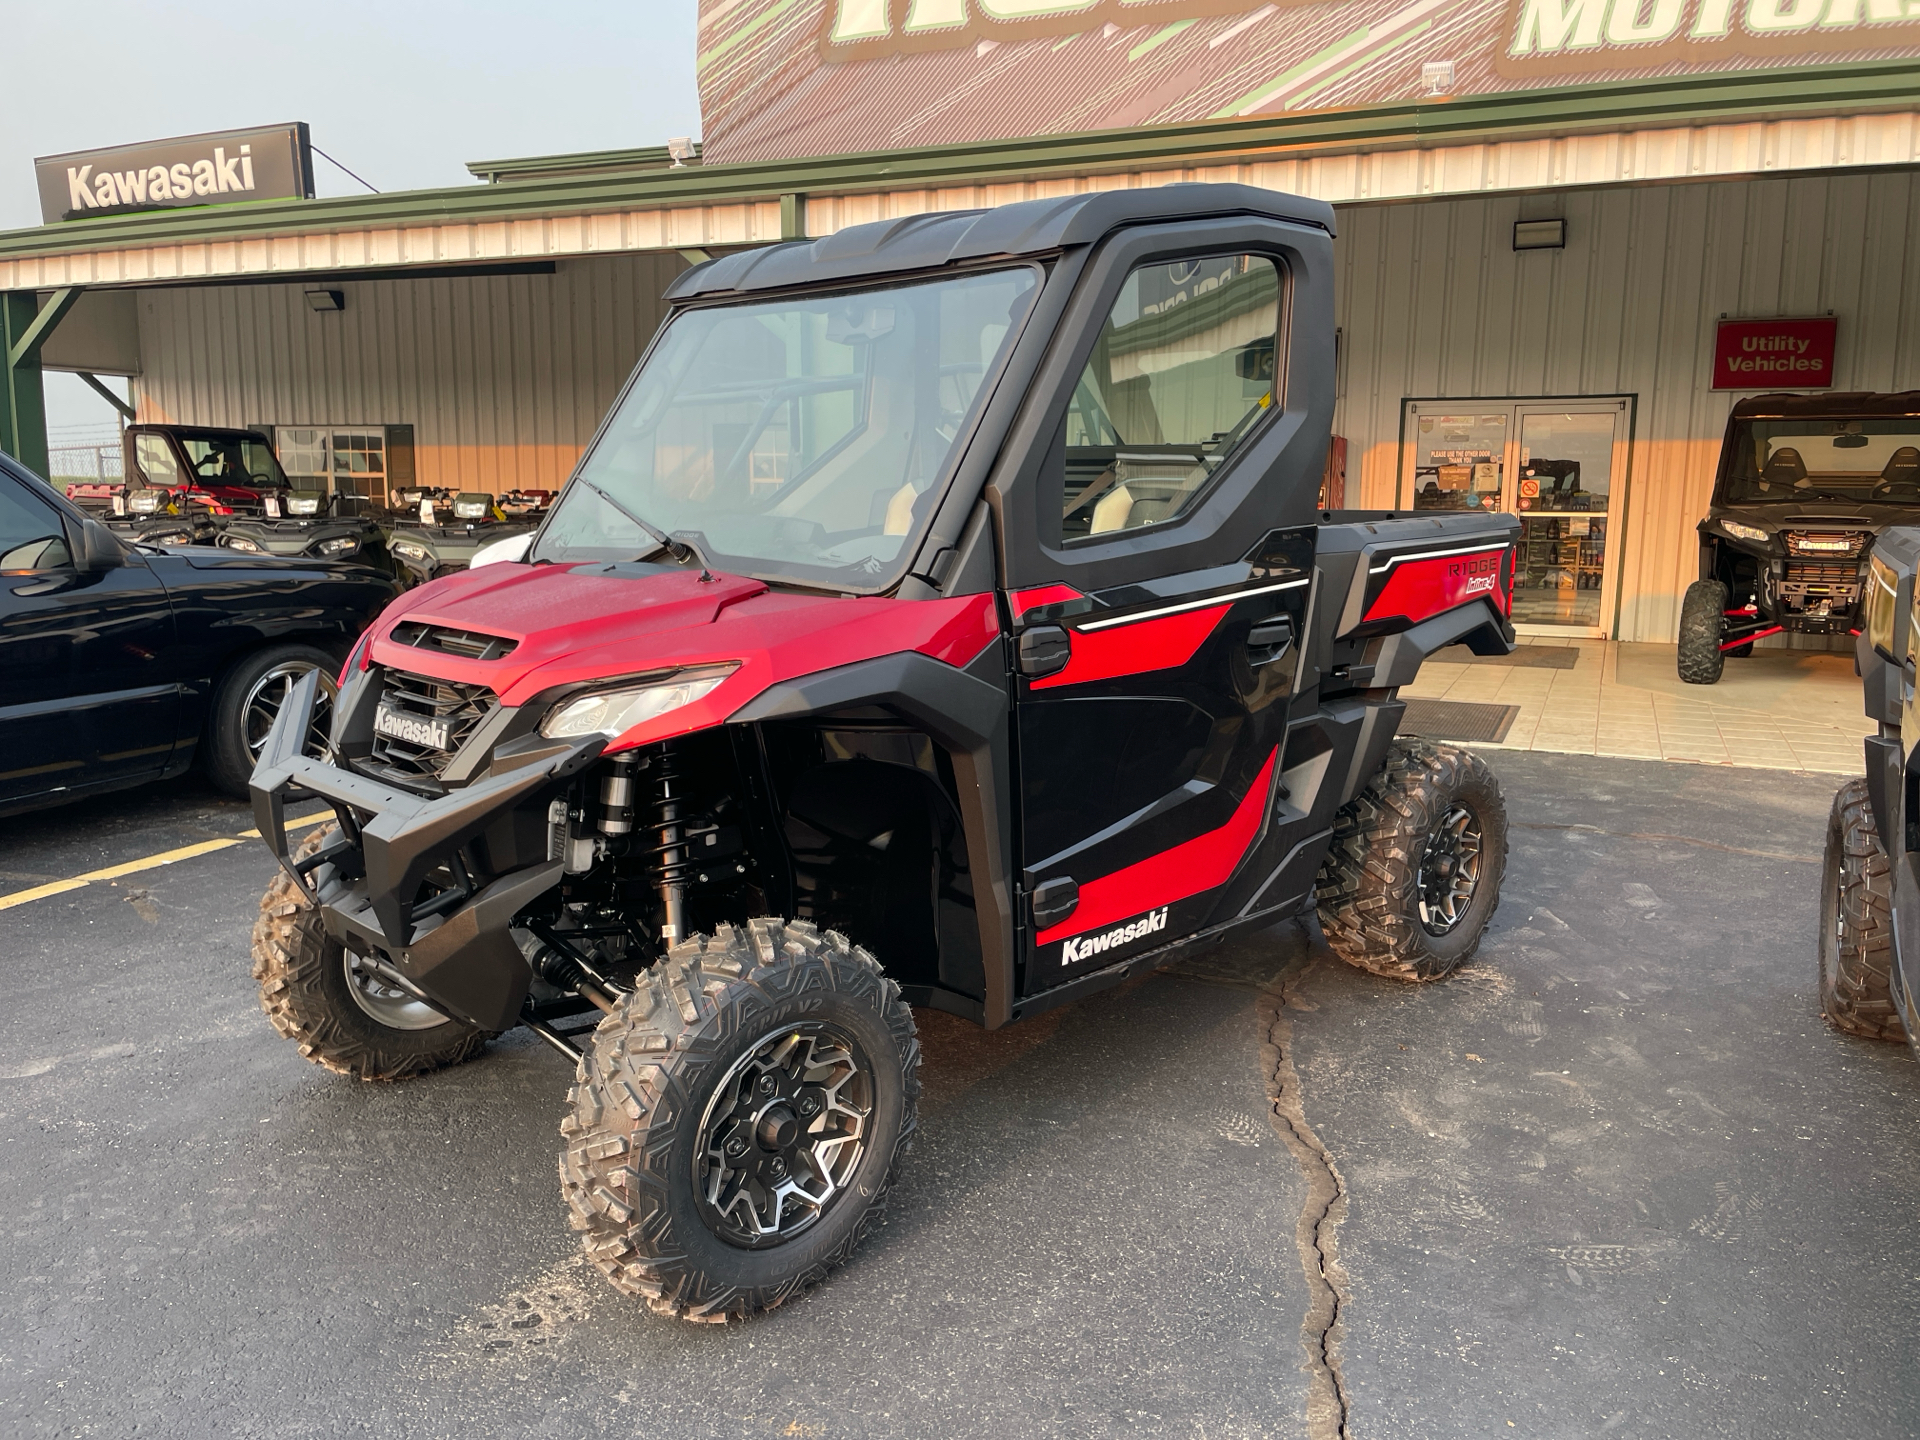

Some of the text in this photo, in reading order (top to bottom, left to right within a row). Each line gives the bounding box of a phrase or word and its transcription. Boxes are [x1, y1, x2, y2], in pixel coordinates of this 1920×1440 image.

[67, 144, 255, 210] Kawasaki
[1742, 336, 1811, 353] Utility
[1727, 356, 1823, 372] Vehicles
[1430, 450, 1490, 458] PLEASE USE THE OTHER DOOR
[1798, 541, 1850, 550] Kawasaki
[1449, 558, 1496, 577] RIDGE
[374, 705, 448, 750] Kawasaki
[1061, 906, 1168, 966] Kawasaki
[797, 998, 823, 1014] V2
